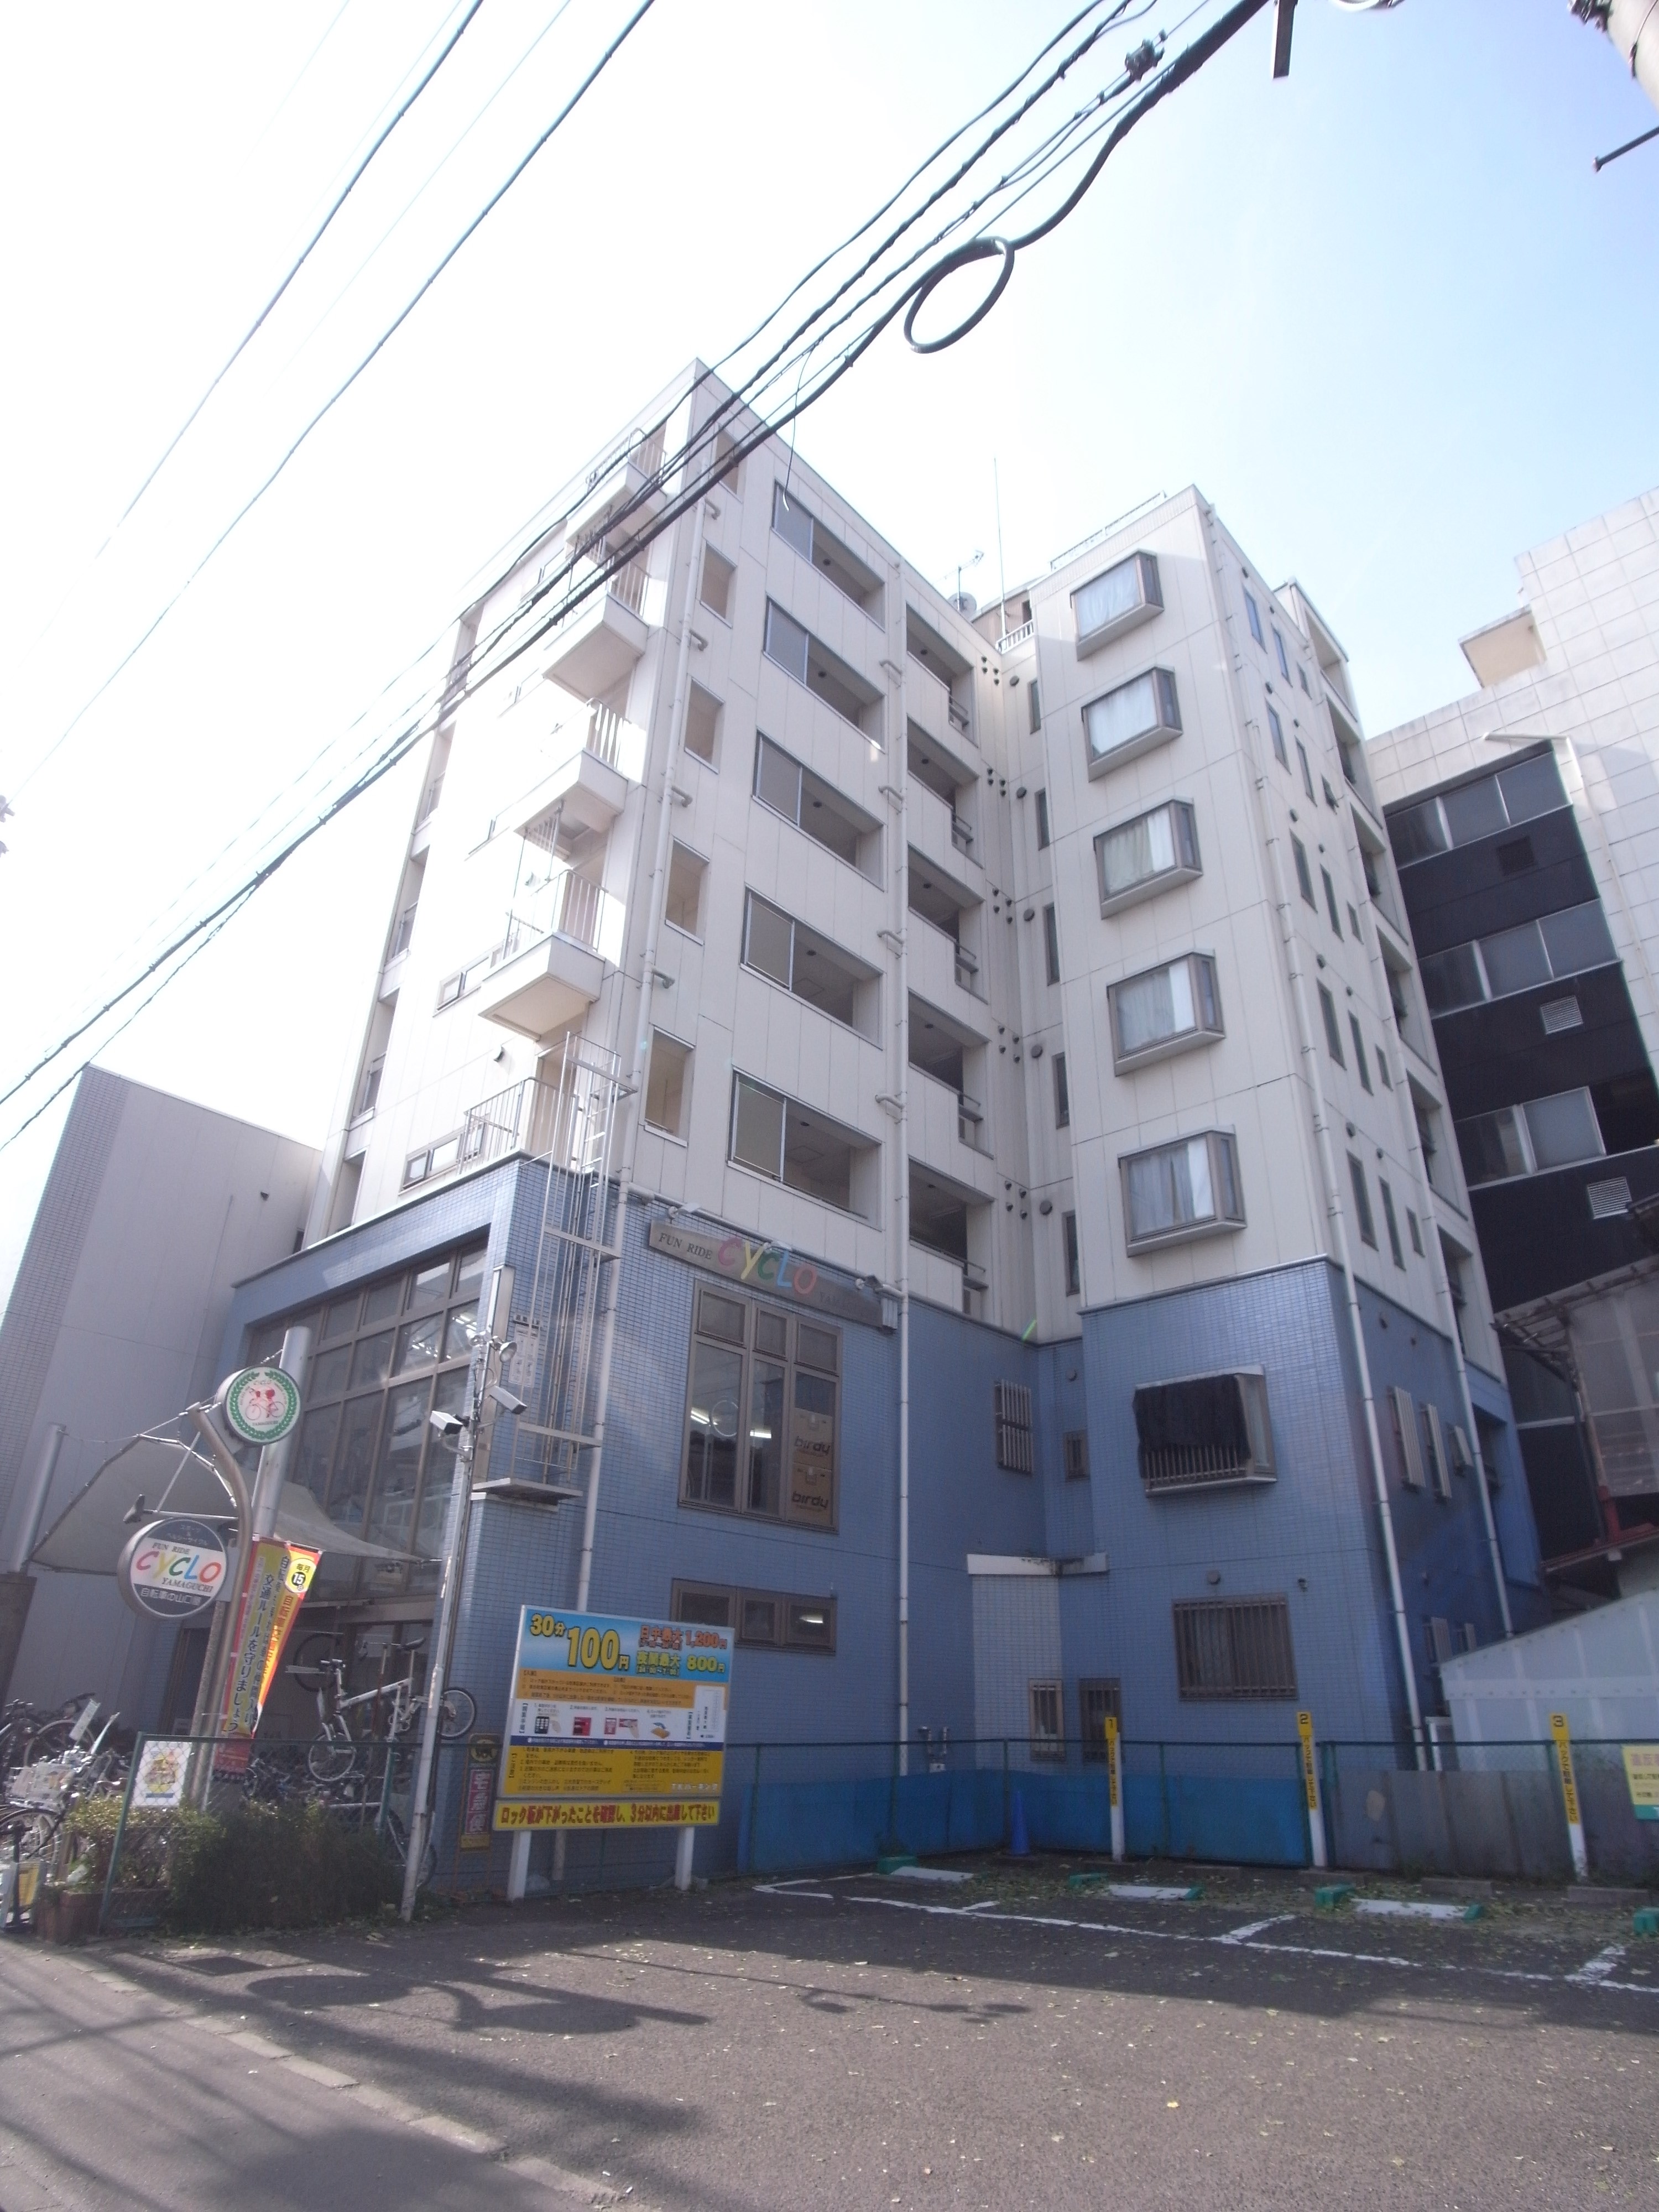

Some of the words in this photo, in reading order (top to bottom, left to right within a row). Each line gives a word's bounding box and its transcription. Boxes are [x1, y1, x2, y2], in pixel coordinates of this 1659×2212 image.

[659, 1232, 682, 1248] FUN
[687, 1242, 712, 1260] RIDE
[719, 1237, 817, 1295] CYCLO
[795, 1436, 830, 1455] birdy
[791, 1491, 828, 1509] birdy
[171, 1546, 191, 1554] RIDE
[136, 1550, 222, 1583] CYCLO
[161, 1578, 213, 1593] YAMAGUCHI
[530, 1613, 566, 1637] 30分
[567, 1626, 630, 1671] 100円
[1109, 1719, 1113, 1728] 1
[1301, 1714, 1308, 1725] 2
[1553, 1715, 1564, 1727] 3
